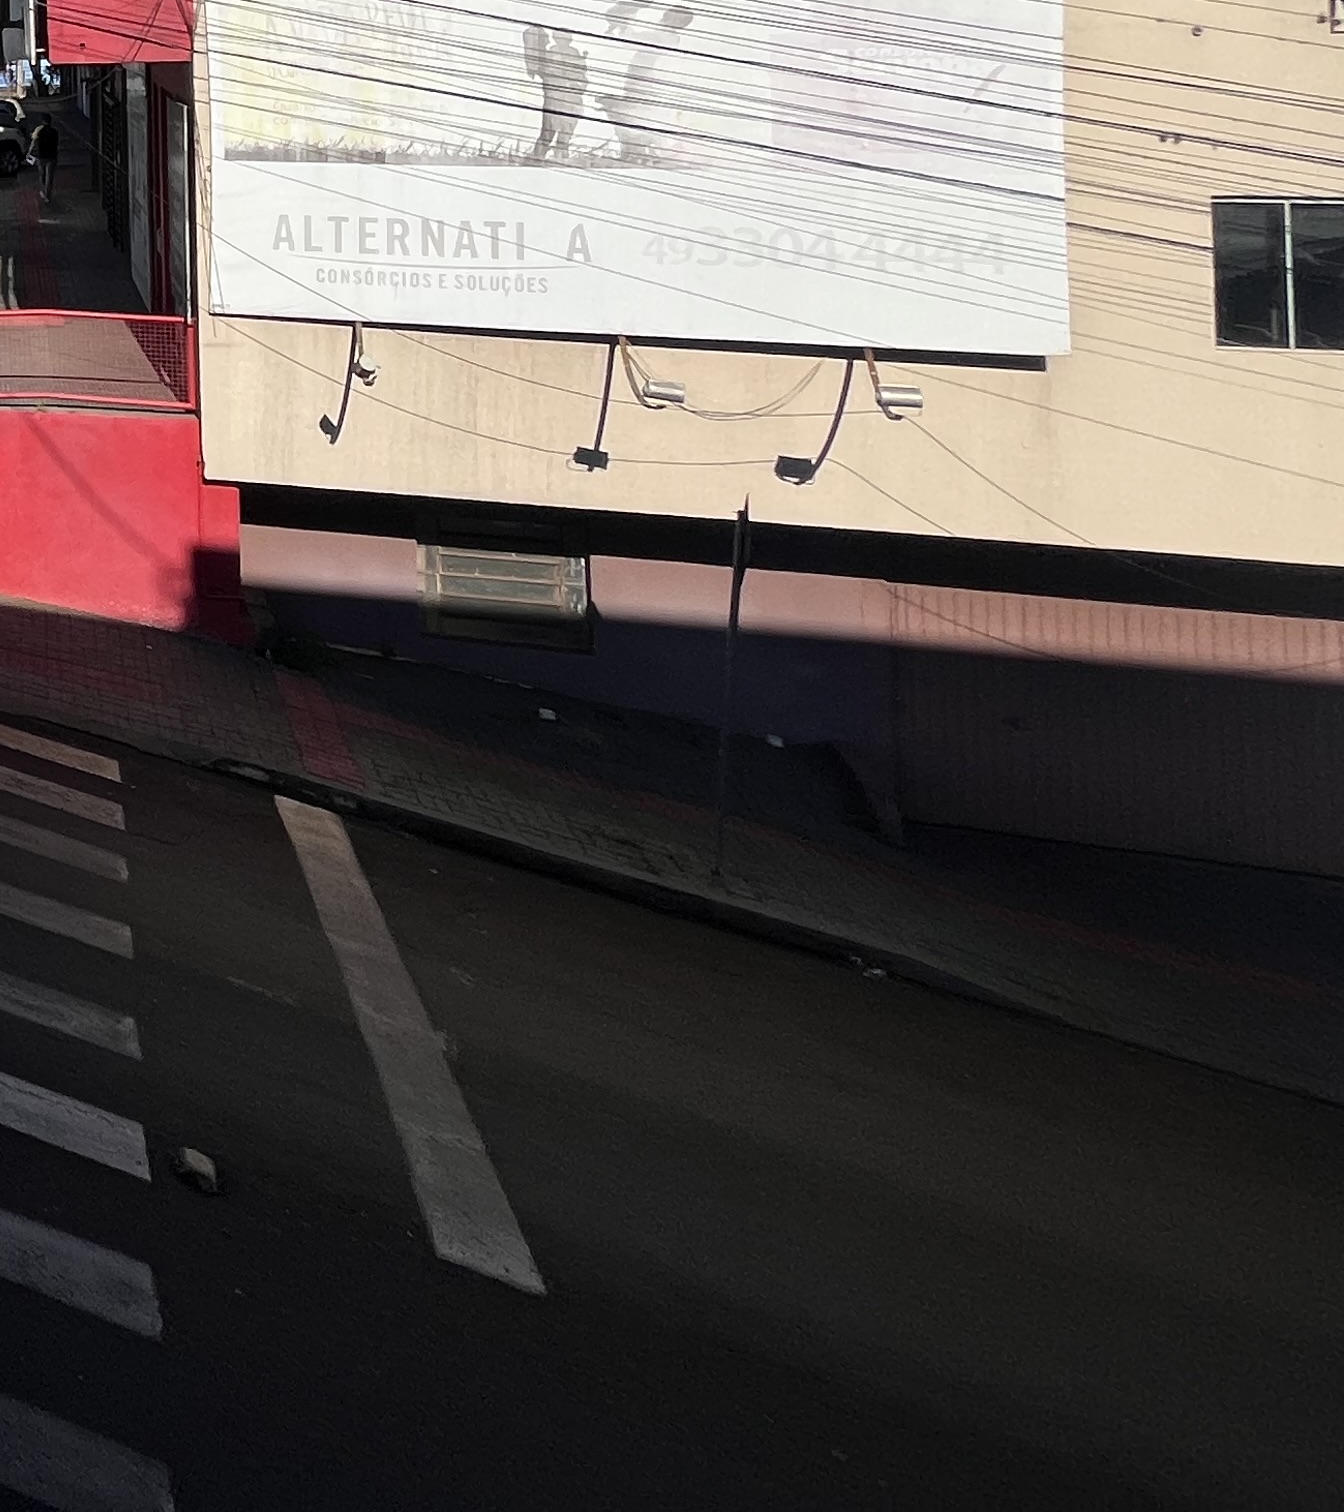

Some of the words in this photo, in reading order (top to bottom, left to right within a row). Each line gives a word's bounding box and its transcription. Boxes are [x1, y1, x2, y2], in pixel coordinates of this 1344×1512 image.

[316, 266, 431, 289] CONSÓRCIOS
[439, 273, 447, 289] E
[454, 273, 548, 296] SOLUÇÕES
